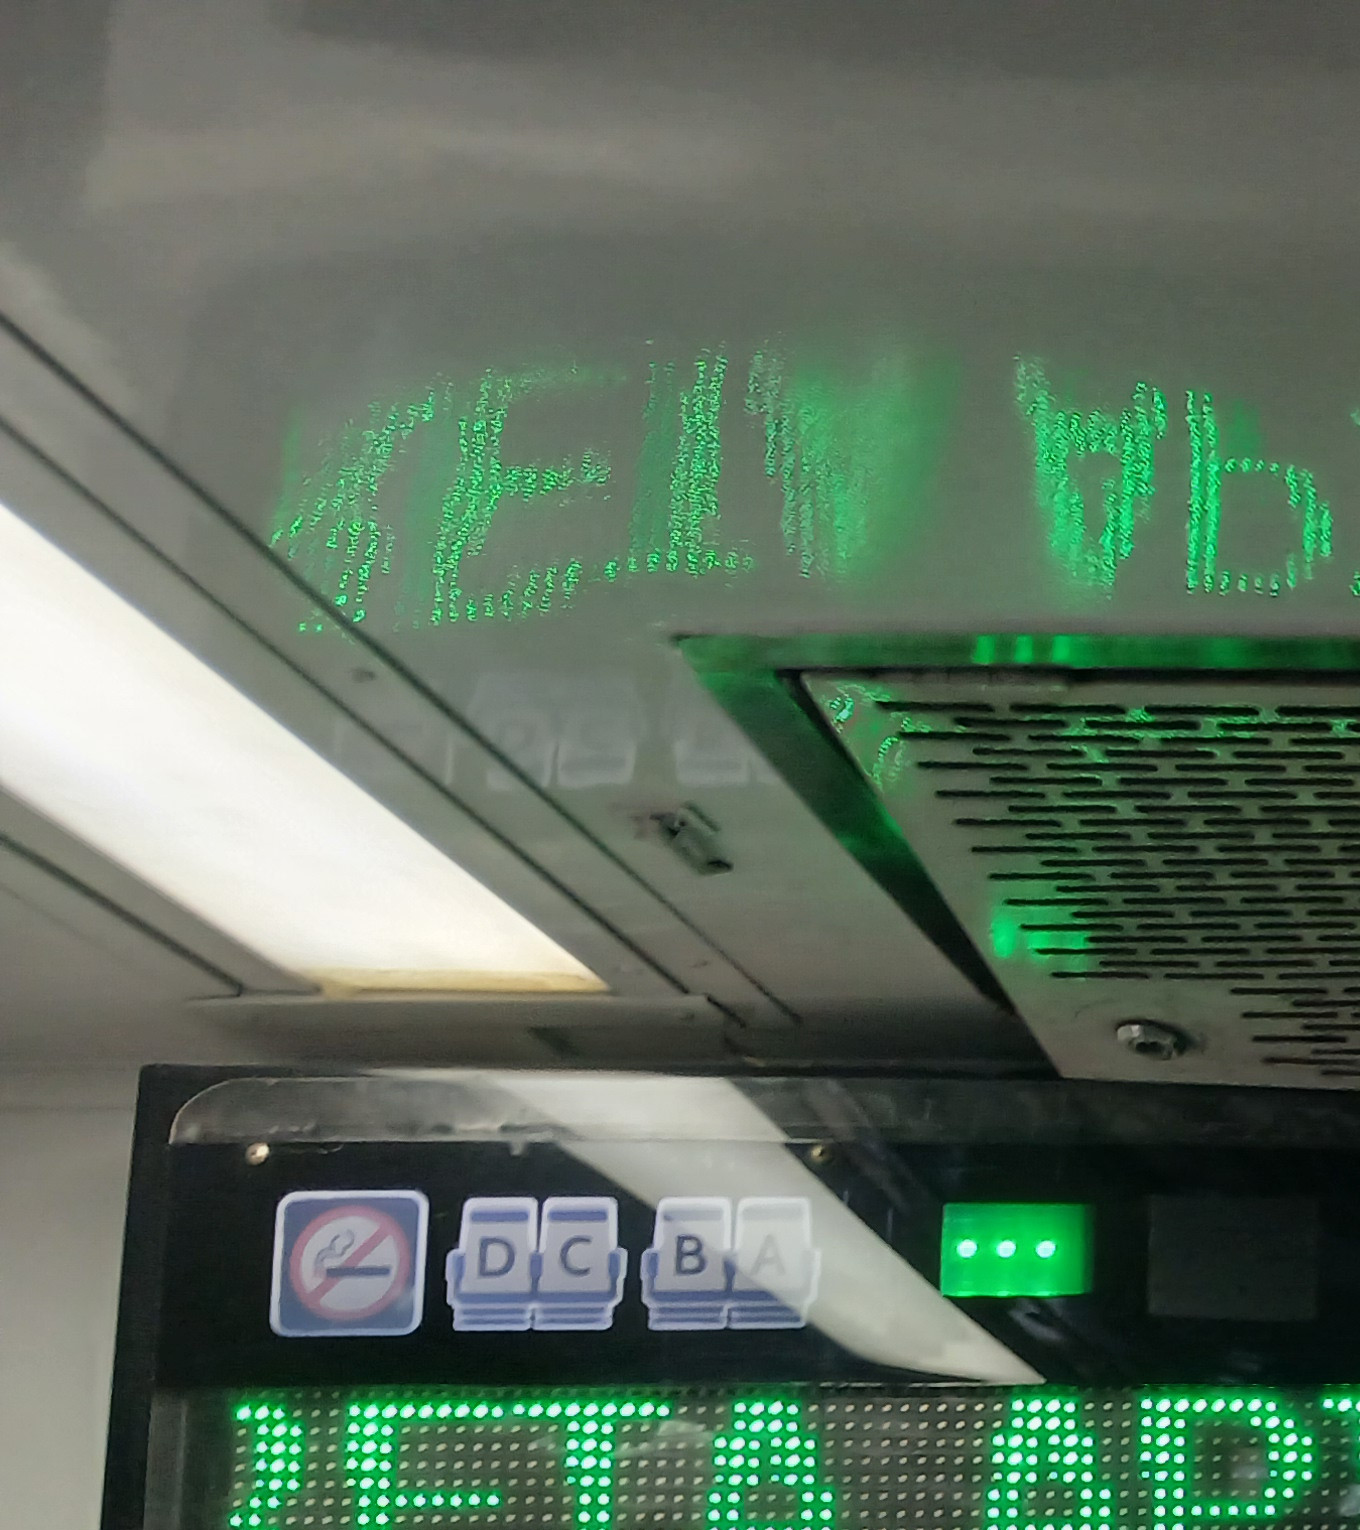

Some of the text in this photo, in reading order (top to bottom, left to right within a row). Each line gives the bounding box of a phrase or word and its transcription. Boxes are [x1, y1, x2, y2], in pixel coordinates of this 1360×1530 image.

[477, 1233, 786, 1277] D C B A
